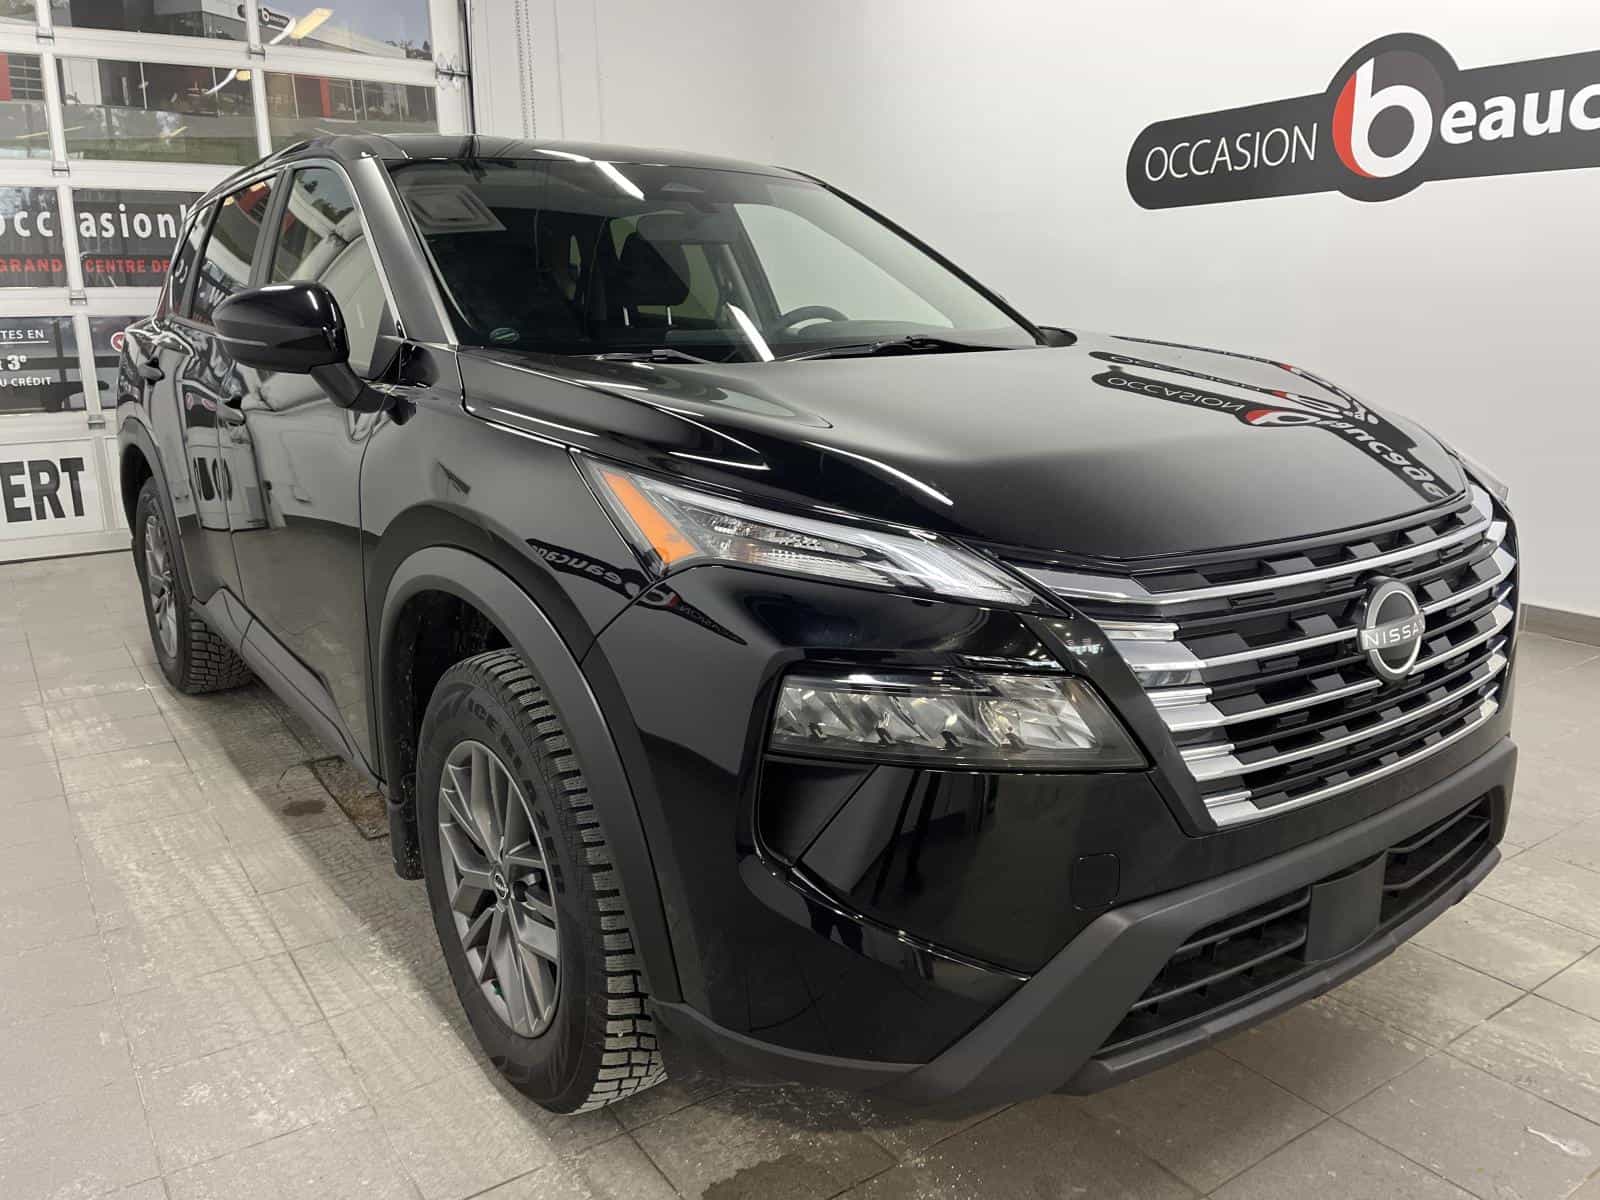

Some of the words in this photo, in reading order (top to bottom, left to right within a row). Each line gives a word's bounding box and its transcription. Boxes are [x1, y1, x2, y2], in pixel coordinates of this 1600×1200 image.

[1145, 122, 1318, 182] OCCASION
[0, 258, 63, 272] GRAND
[85, 259, 145, 272] CENTRE
[28, 329, 45, 339] EN
[11, 376, 51, 387] CRÉDIT
[0, 457, 84, 522] ERT
